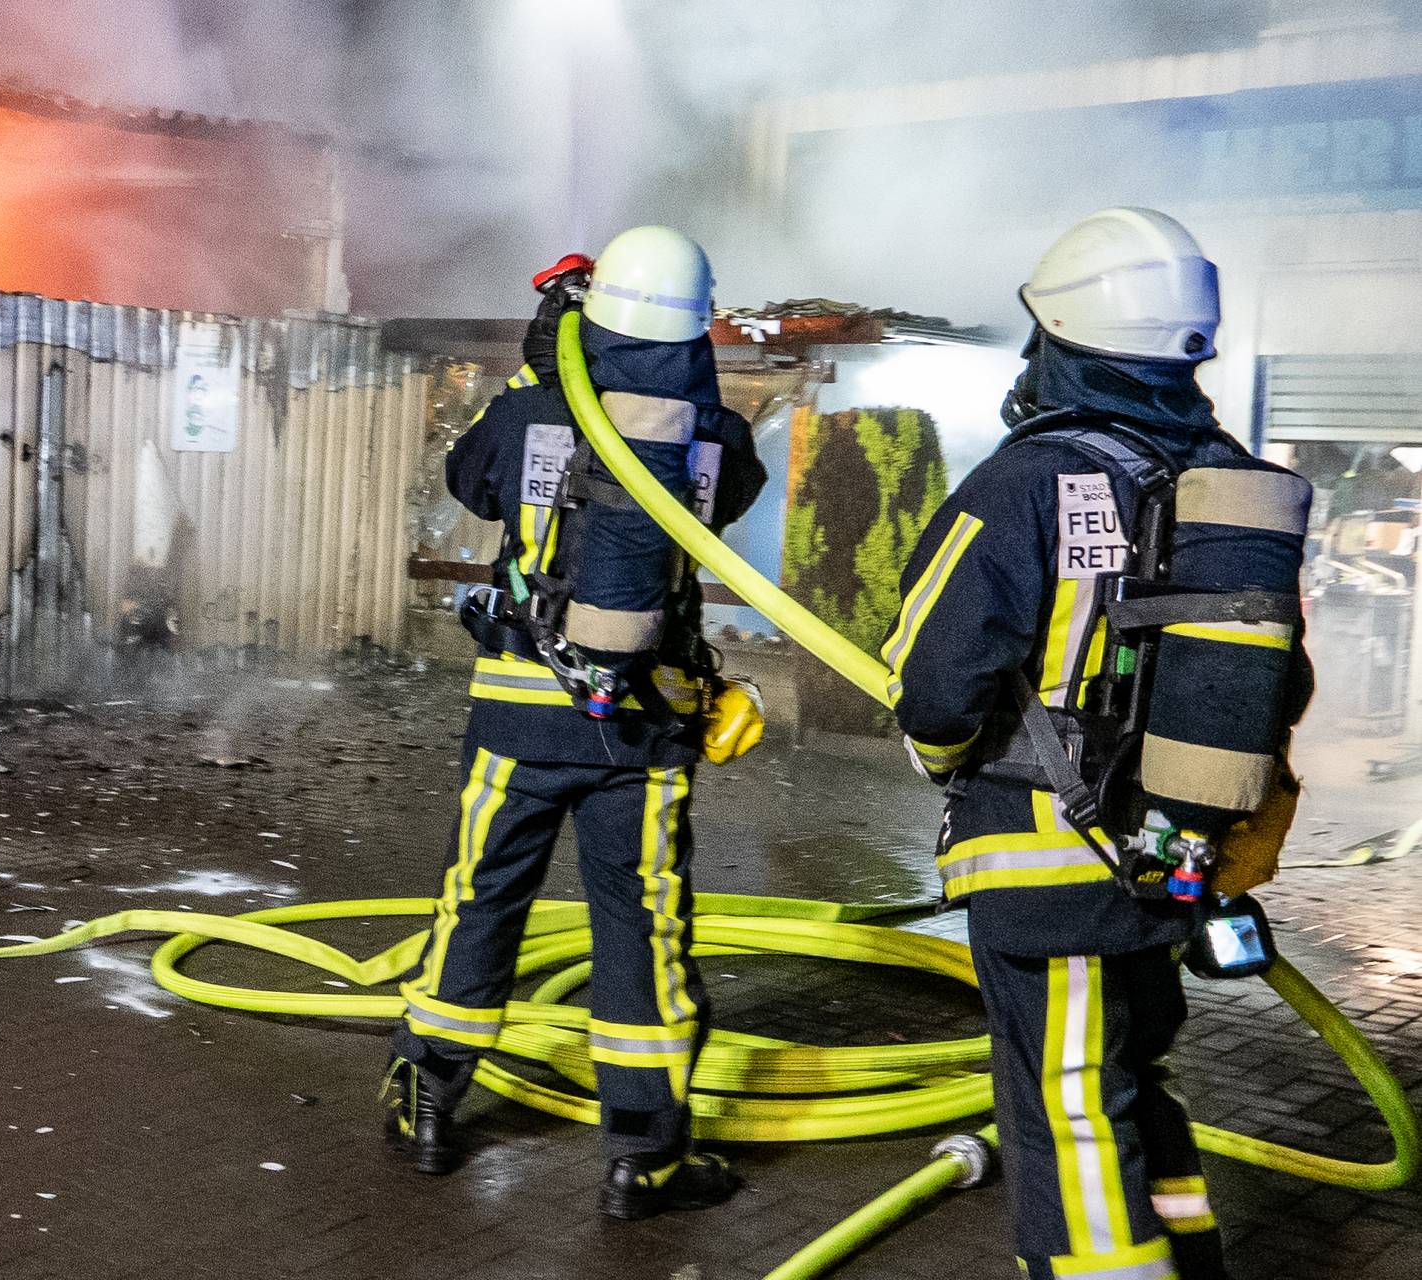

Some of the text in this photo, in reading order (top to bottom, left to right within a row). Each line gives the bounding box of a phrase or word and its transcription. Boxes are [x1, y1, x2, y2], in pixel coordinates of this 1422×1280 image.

[528, 479, 558, 498] RE
[1079, 483, 1110, 493] STAD
[1067, 511, 1118, 535] FEU
